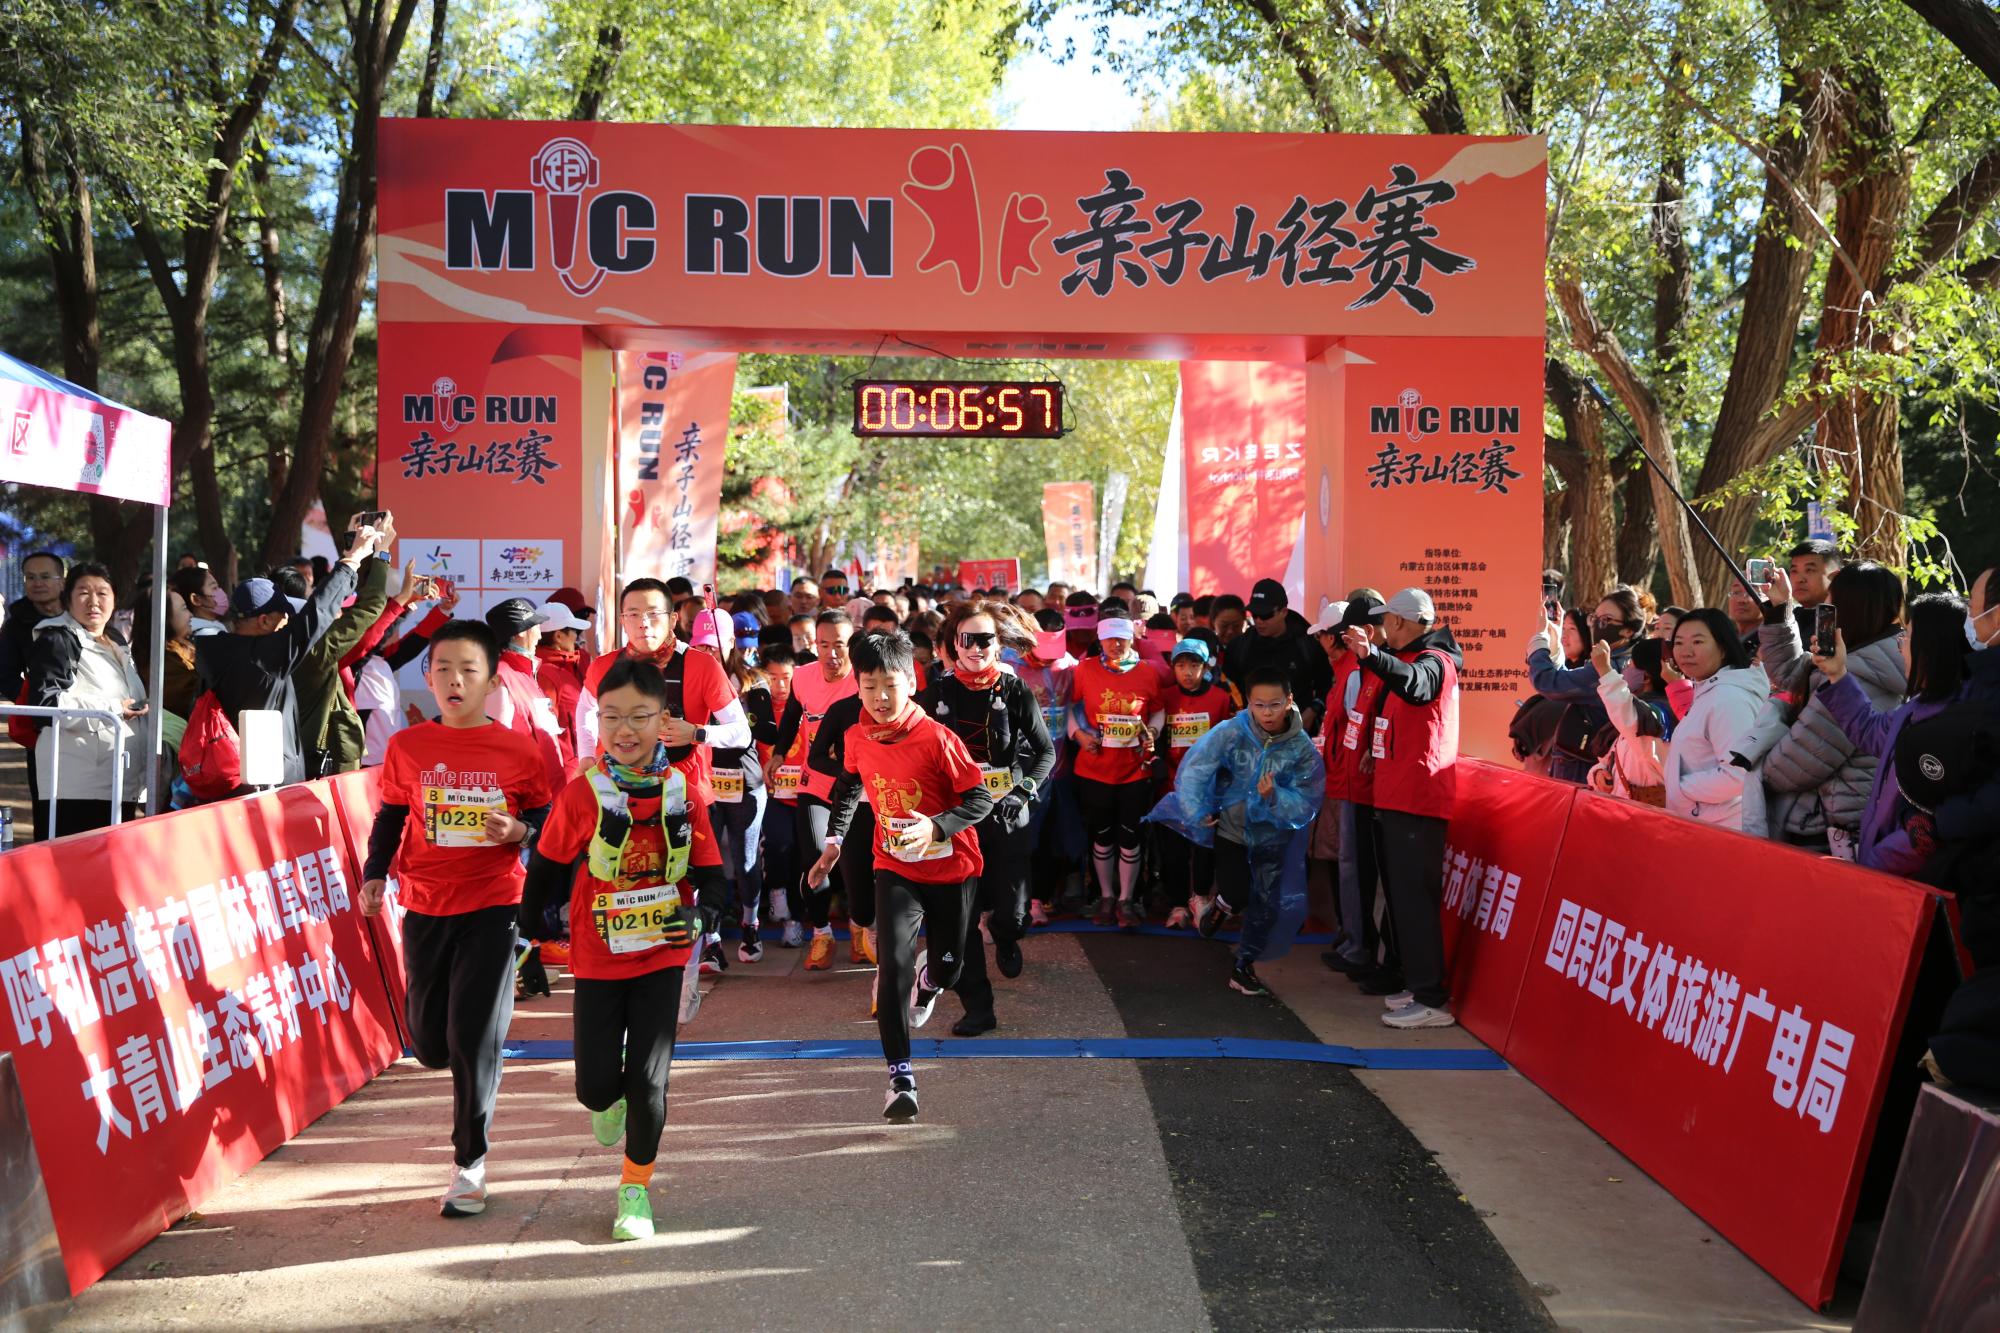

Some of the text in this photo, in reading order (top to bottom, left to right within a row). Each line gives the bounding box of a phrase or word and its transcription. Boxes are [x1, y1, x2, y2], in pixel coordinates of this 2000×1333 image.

[445, 150, 894, 290] MIC RUN
[1052, 165, 1478, 316] 亲子山径赛
[403, 385, 557, 430] MIC RUN
[862, 387, 1052, 431] 00:06:57
[1370, 395, 1520, 440] MIC RUN
[401, 428, 561, 486] 亲子山径赛
[638, 402, 665, 481] RUN
[1367, 438, 1525, 495] 亲子山径赛
[1400, 562, 1487, 571] 内蒙古自治区体育总会
[1424, 549, 1462, 558] 指导单位:
[1424, 576, 1462, 584] 主办单位:
[1105, 726, 1132, 736] 0600
[1173, 725, 1198, 736] 0229
[429, 790, 439, 801] B
[460, 772, 497, 786] RUN
[447, 793, 485, 803] MIC RUN
[597, 895, 607, 907] B
[617, 893, 656, 906] MIC RUN
[612, 909, 664, 931] 0216
[0, 846, 351, 1048] 呼和浩特市园林和草原局
[1545, 898, 1855, 1133] 回民区文体旅游广电局
[81, 943, 351, 1156] 大青山生态养护中心
